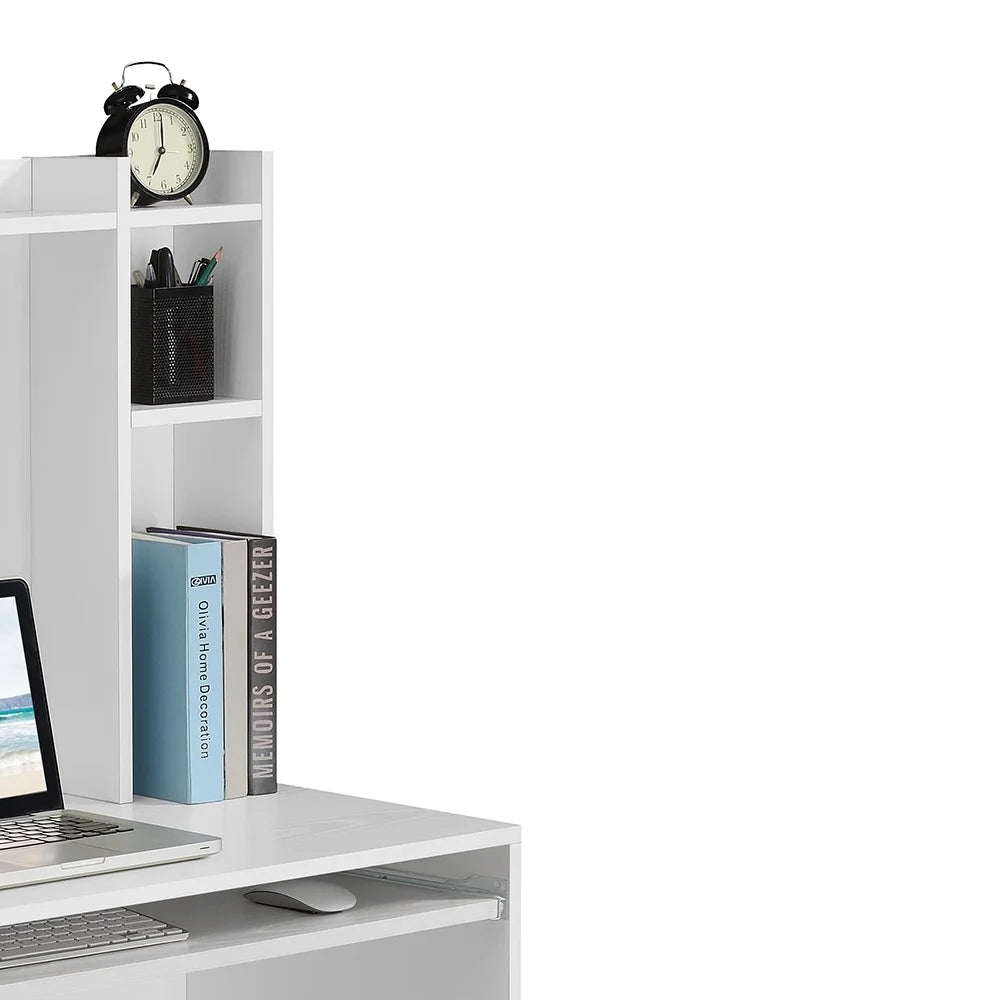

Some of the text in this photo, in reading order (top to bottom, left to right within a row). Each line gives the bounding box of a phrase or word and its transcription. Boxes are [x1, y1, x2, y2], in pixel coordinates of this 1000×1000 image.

[140, 119, 147, 128] 11
[181, 127, 187, 136] 2
[131, 132, 139, 142] 10
[187, 143, 193, 153] 3
[134, 165, 140, 174] 8
[184, 161, 189, 170] 4
[147, 175, 152, 185] 7
[176, 174, 181, 184] 5
[161, 180, 167, 189] 6
[252, 546, 274, 779] MEMOIRS OF A GEEZER
[198, 600, 210, 759] Olivia Home Decoration
